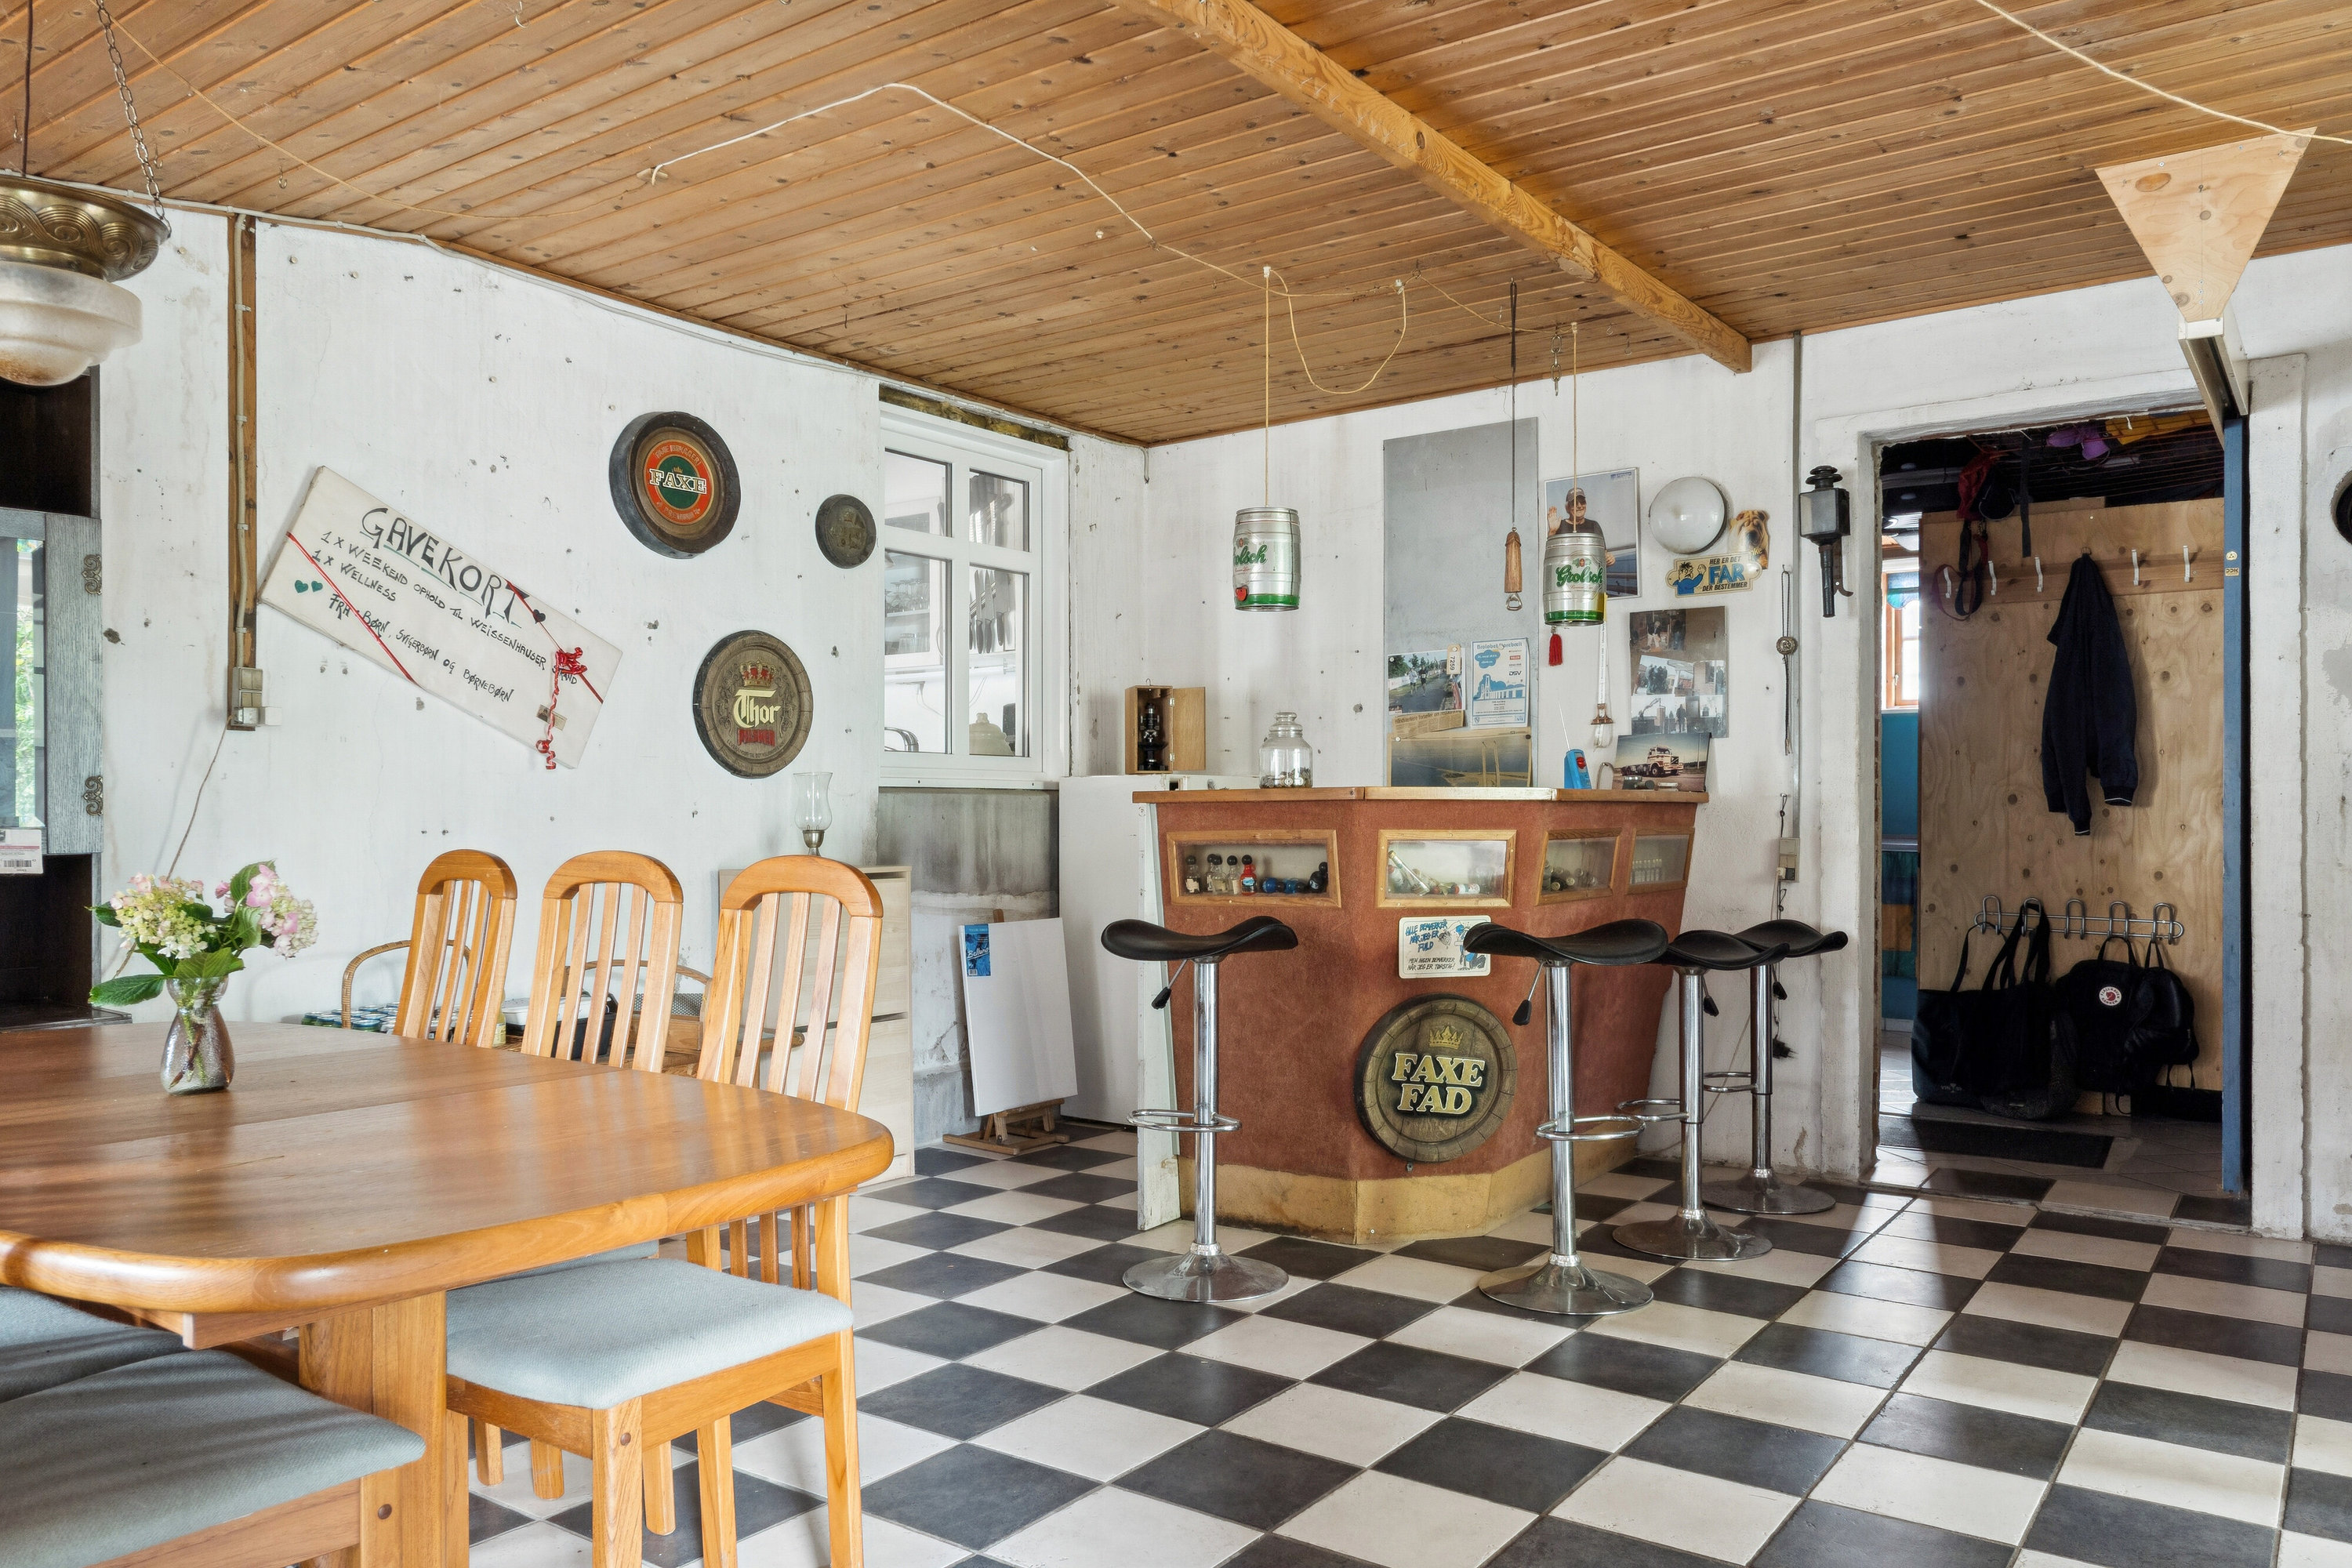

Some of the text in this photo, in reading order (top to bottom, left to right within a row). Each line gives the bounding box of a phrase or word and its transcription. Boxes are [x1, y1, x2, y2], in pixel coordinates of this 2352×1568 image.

[648, 468, 707, 495] FAXE
[312, 549, 321, 563] 1
[340, 561, 397, 602] WELLNESS
[321, 531, 332, 544] 1
[349, 543, 408, 585] WEEKEND
[413, 583, 445, 609] OPHOLD
[362, 507, 530, 623] GAVEKORT
[1555, 564, 1603, 587] Grolsch
[1708, 563, 1745, 585] FAR
[1714, 581, 1748, 590] BESTEMMER
[396, 629, 440, 661] SVIGERBØRN
[442, 658, 456, 674] OG
[733, 688, 782, 728] Thor
[1417, 941, 1434, 953] FULD
[1432, 930, 1439, 939] ER
[1391, 1052, 1486, 1087] FAXE
[1396, 1083, 1472, 1115] FAD
